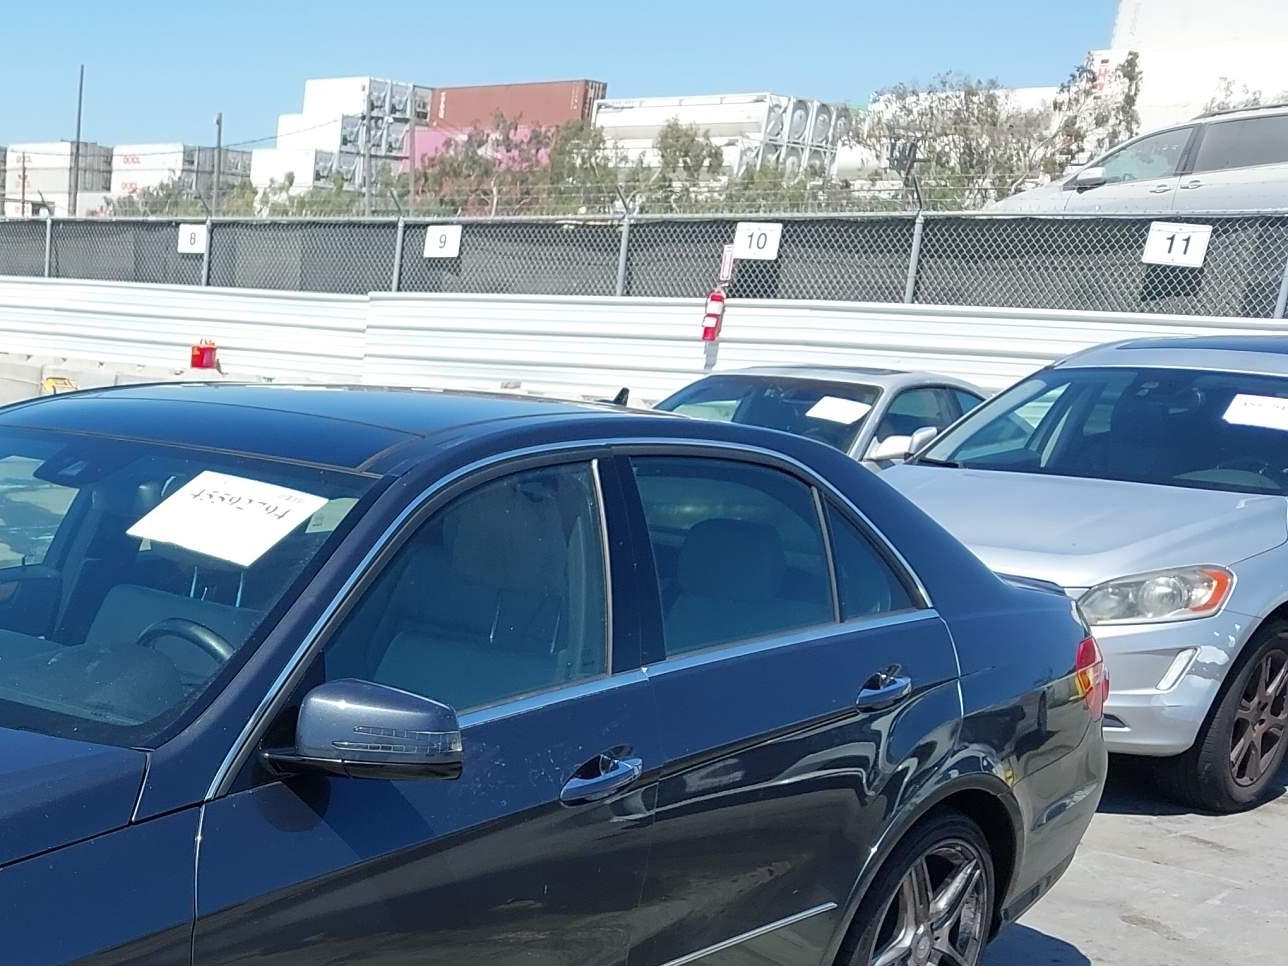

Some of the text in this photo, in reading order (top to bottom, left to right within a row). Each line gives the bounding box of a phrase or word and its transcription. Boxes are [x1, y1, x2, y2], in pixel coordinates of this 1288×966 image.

[189, 231, 197, 246] 8
[438, 233, 447, 249] 9
[747, 231, 768, 250] 10
[1165, 233, 1192, 255] 11
